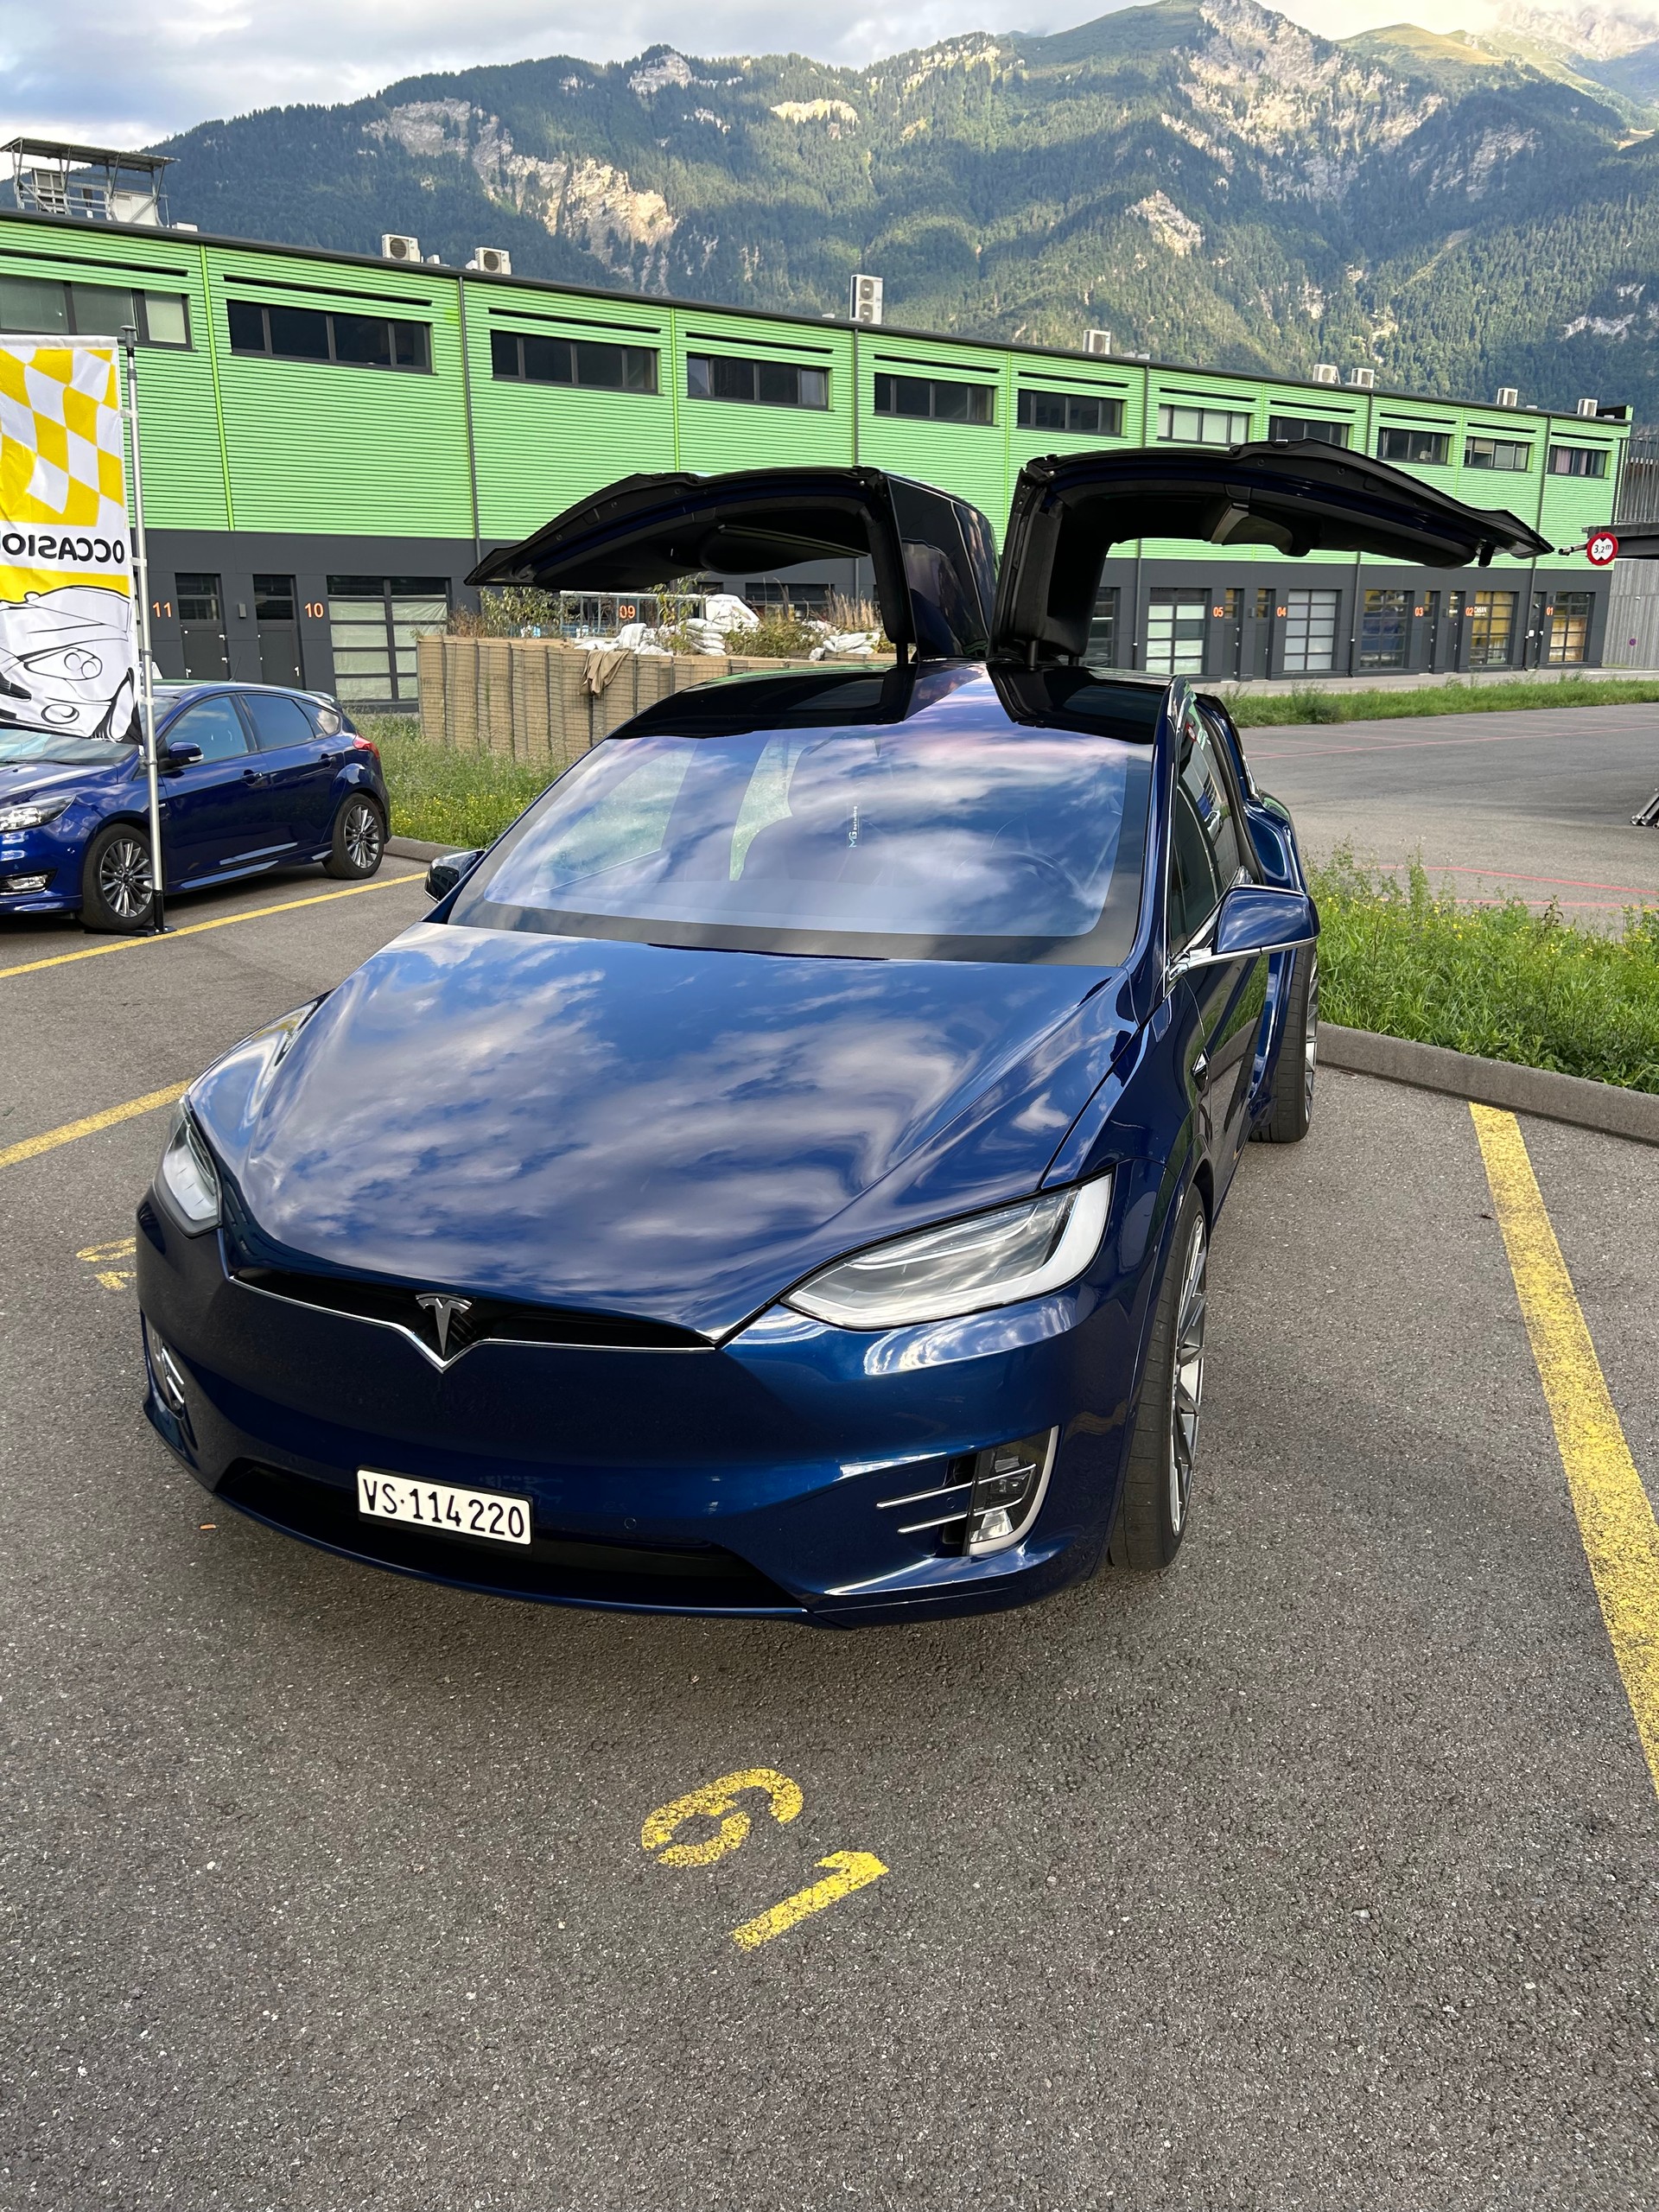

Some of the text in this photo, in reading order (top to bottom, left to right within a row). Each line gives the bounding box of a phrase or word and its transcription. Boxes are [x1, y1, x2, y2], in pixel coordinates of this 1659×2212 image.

[152, 601, 173, 618] 11
[304, 602, 324, 619] 10
[619, 605, 636, 620] 09
[1212, 606, 1224, 618] 05
[1276, 607, 1287, 618] 04
[1414, 607, 1424, 617] 03
[1465, 607, 1474, 616] 02
[1546, 607, 1554, 616] 01
